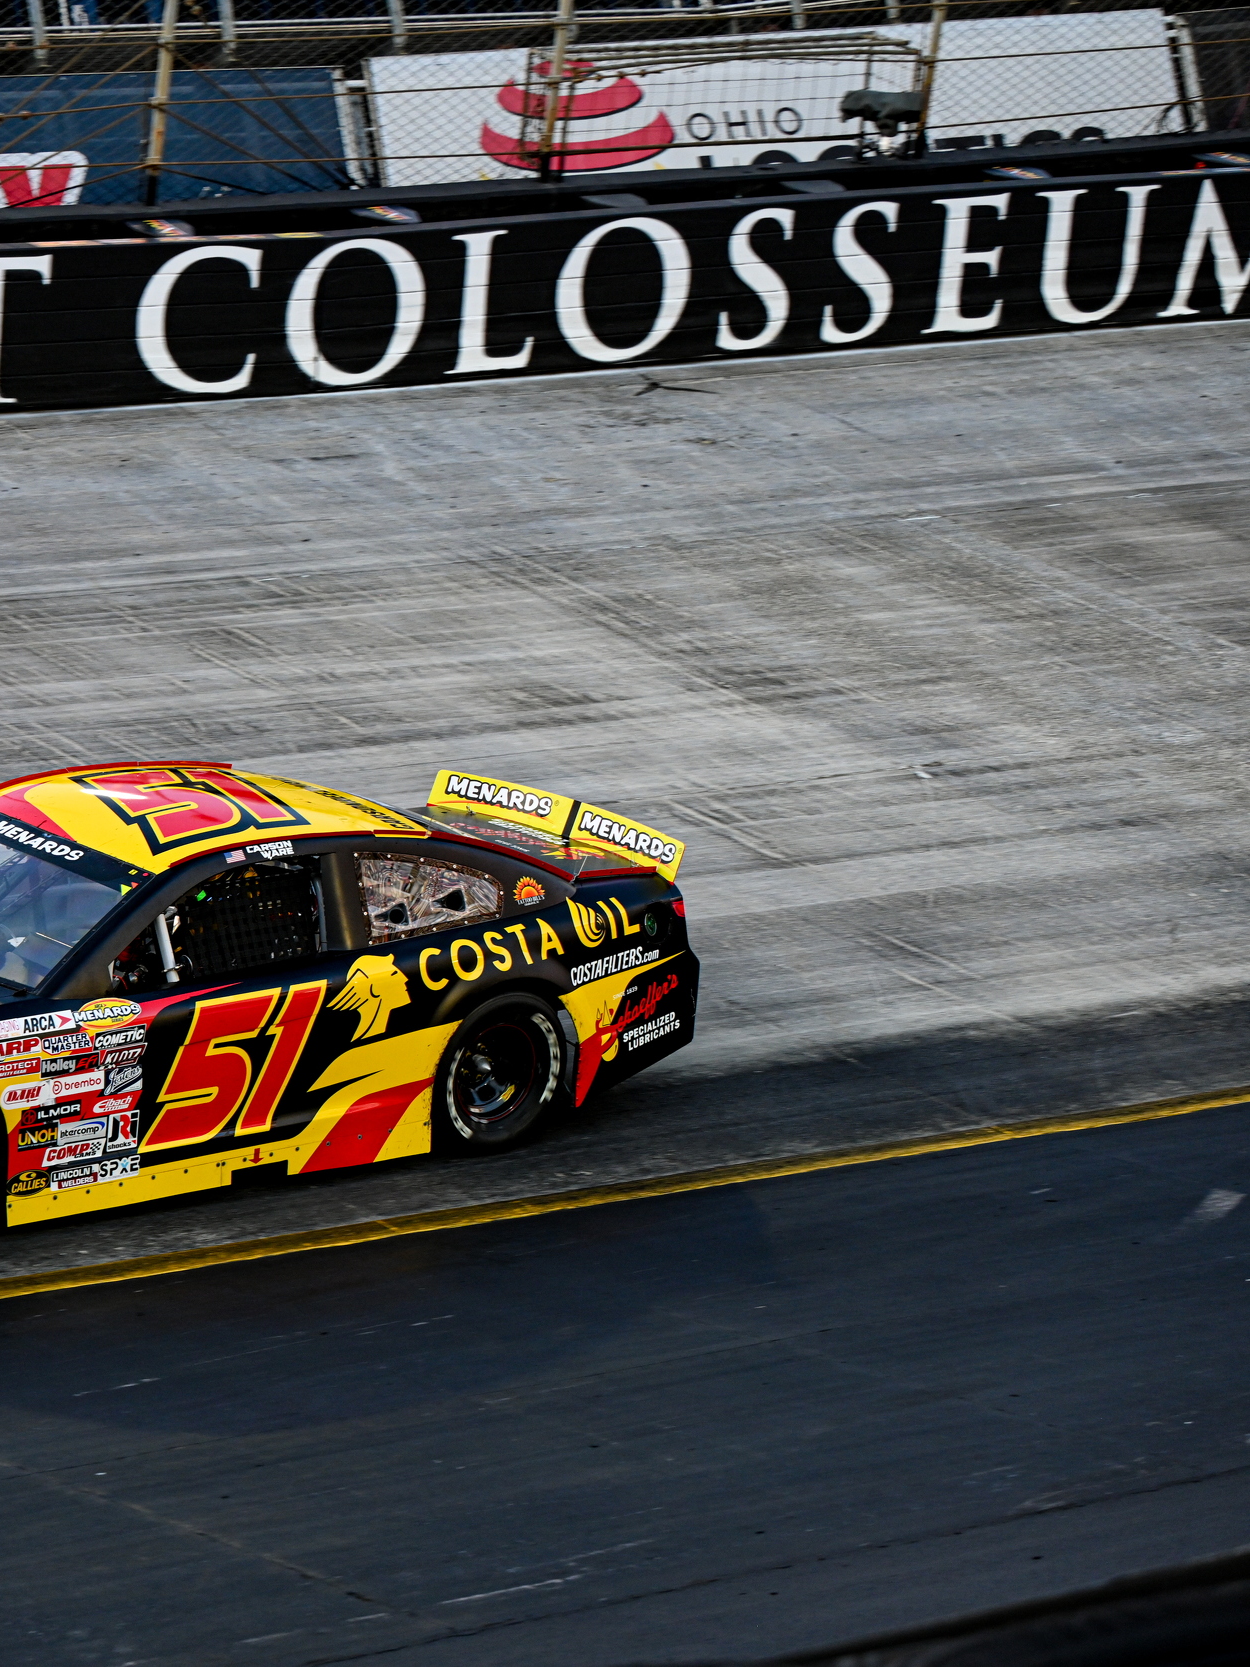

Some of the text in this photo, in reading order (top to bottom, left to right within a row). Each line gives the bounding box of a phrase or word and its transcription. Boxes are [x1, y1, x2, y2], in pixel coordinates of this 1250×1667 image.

[685, 106, 803, 141] OHIO
[447, 775, 553, 817] MENARDS
[70, 768, 310, 856] 51
[578, 811, 676, 863] MENARDS
[245, 840, 293, 854] CARSON
[260, 847, 295, 860] WARE
[419, 918, 565, 991] COSTA
[570, 946, 660, 987] COSTAFILTERS.com
[73, 1004, 141, 1023] MENARDS
[23, 1014, 56, 1034] ARCA
[623, 1012, 676, 1043] SPECIALIZED
[42, 1032, 88, 1050] QUARTER
[95, 1028, 145, 1048] COMETIC
[628, 1019, 681, 1051] LUBRICANTS
[51, 1039, 91, 1054] MASTER
[42, 1059, 76, 1074] Holley
[137, 979, 328, 1153] 51
[64, 1077, 102, 1091] brembo
[37, 1104, 81, 1119] ILMOR
[18, 1127, 58, 1146] UNOH
[107, 1141, 132, 1150] shocks
[46, 1143, 91, 1162] COMP
[74, 1150, 97, 1159] CAMS
[53, 1165, 91, 1181] LINCOLN
[61, 1176, 94, 1188] WELDERS
[11, 1178, 46, 1194] CALLIES
